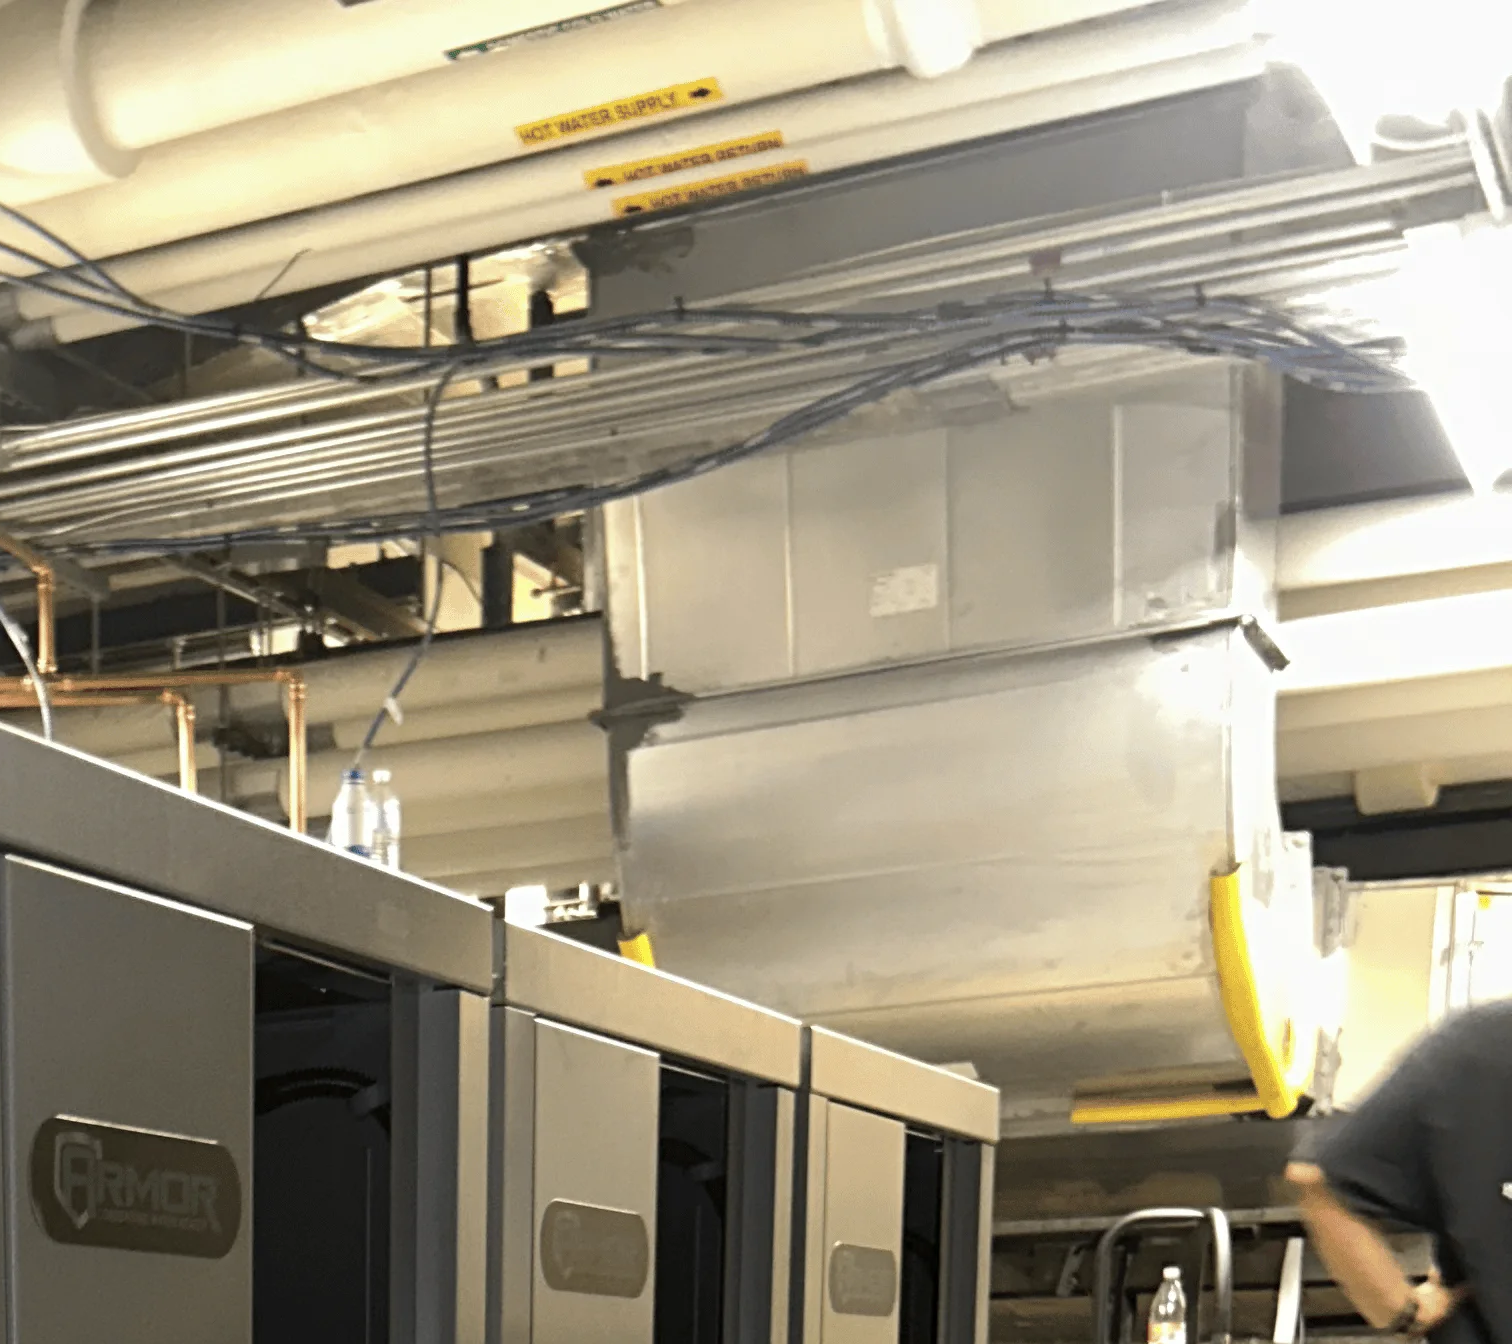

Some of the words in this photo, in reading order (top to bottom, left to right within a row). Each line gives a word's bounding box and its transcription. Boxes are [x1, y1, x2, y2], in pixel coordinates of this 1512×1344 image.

[519, 121, 554, 142] HOT
[559, 108, 611, 135] WATER
[616, 92, 677, 119] SUPPLY
[661, 152, 711, 175] WATER
[61, 1143, 223, 1235] ARMOR
